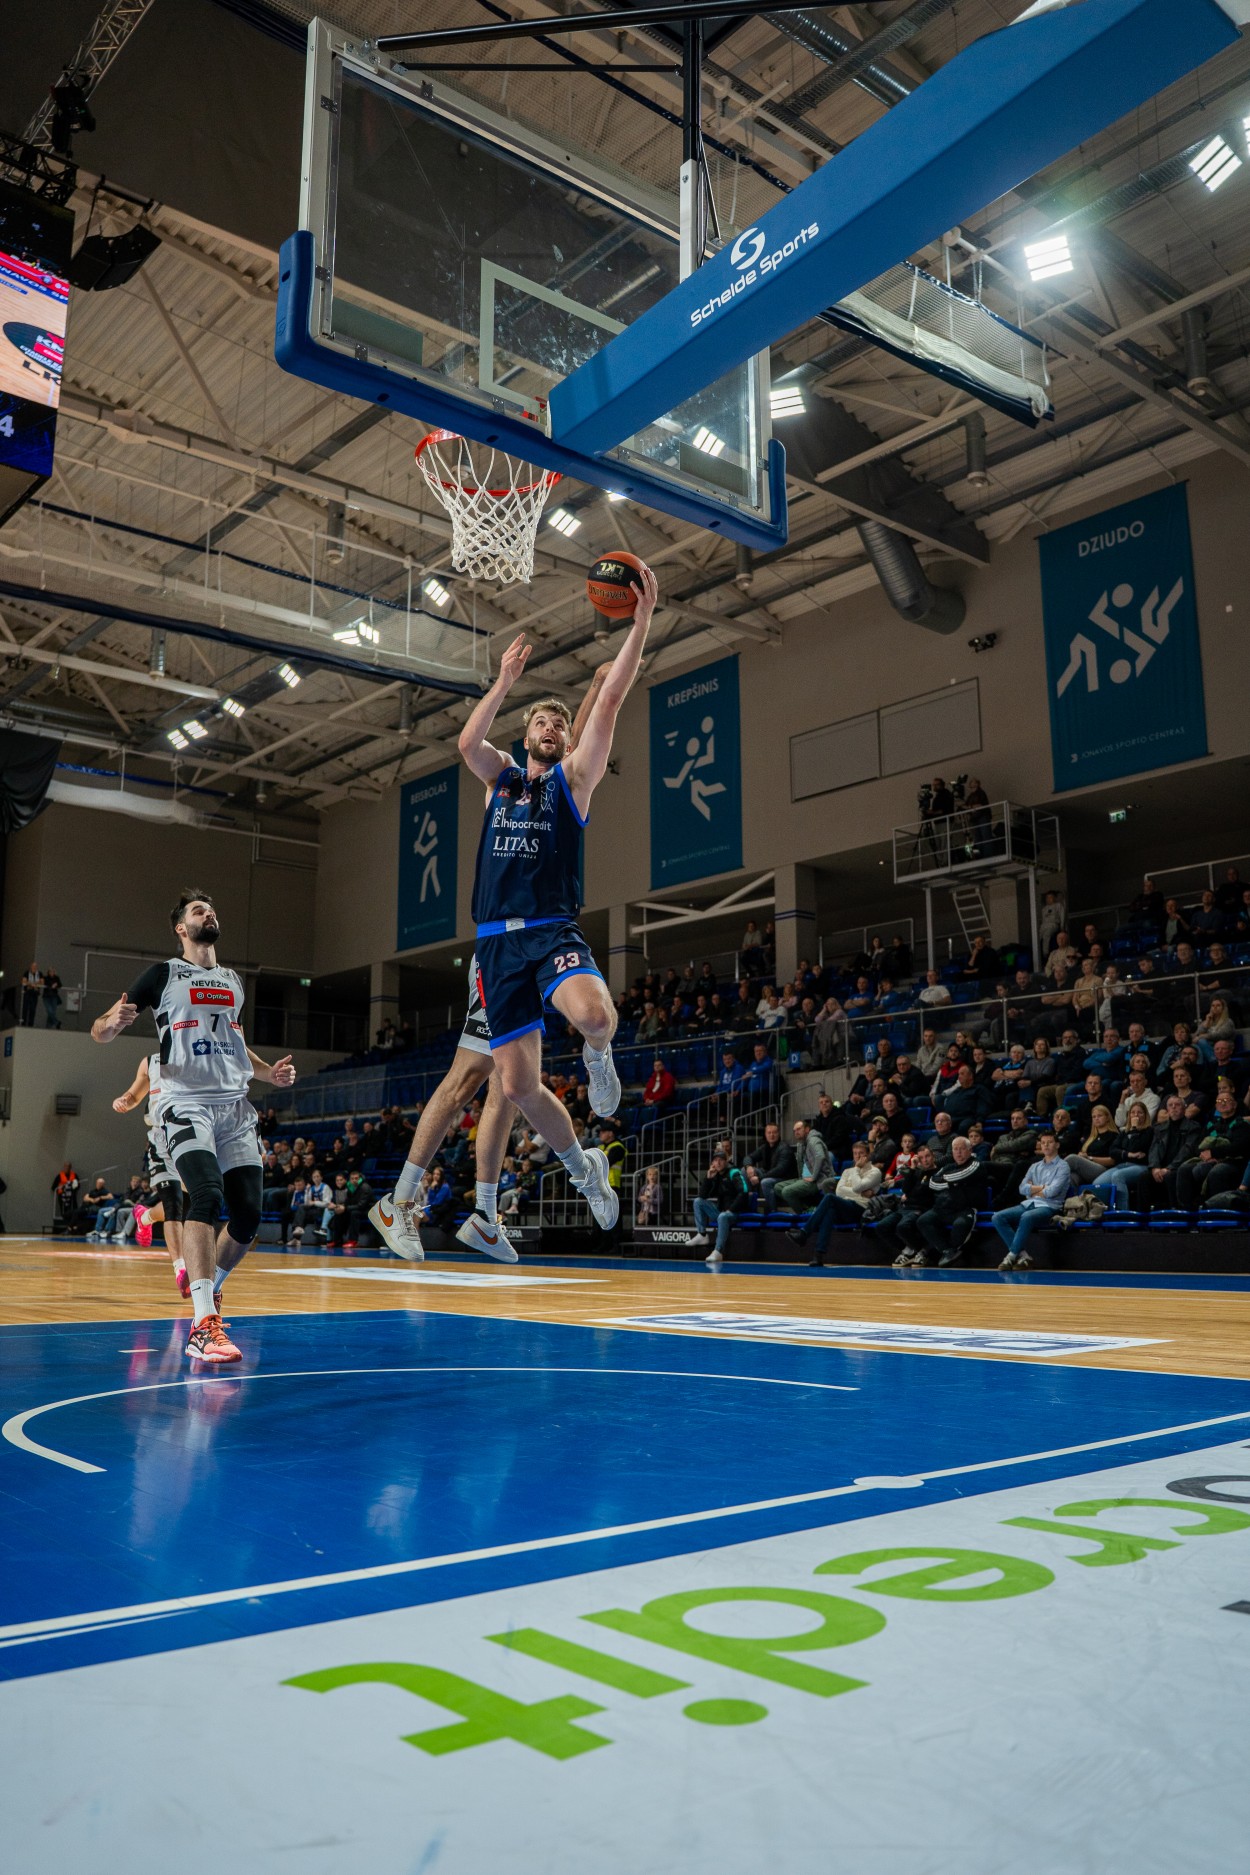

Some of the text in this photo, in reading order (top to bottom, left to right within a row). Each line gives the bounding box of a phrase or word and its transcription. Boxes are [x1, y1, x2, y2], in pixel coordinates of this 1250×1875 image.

[690, 222, 820, 328] Schelde Sports
[1078, 520, 1145, 558] DZIUDO
[588, 582, 629, 601] SPALDING
[667, 677, 719, 709] KREPŠINIS
[410, 782, 448, 806] BEISBOLAS
[503, 818, 552, 832] hipocredit
[493, 836, 540, 853] LITAS
[553, 951, 581, 975] 23
[210, 1013, 220, 1033] 7
[505, 1229, 523, 1239] GORA
[652, 1231, 692, 1242] VAIGORA
